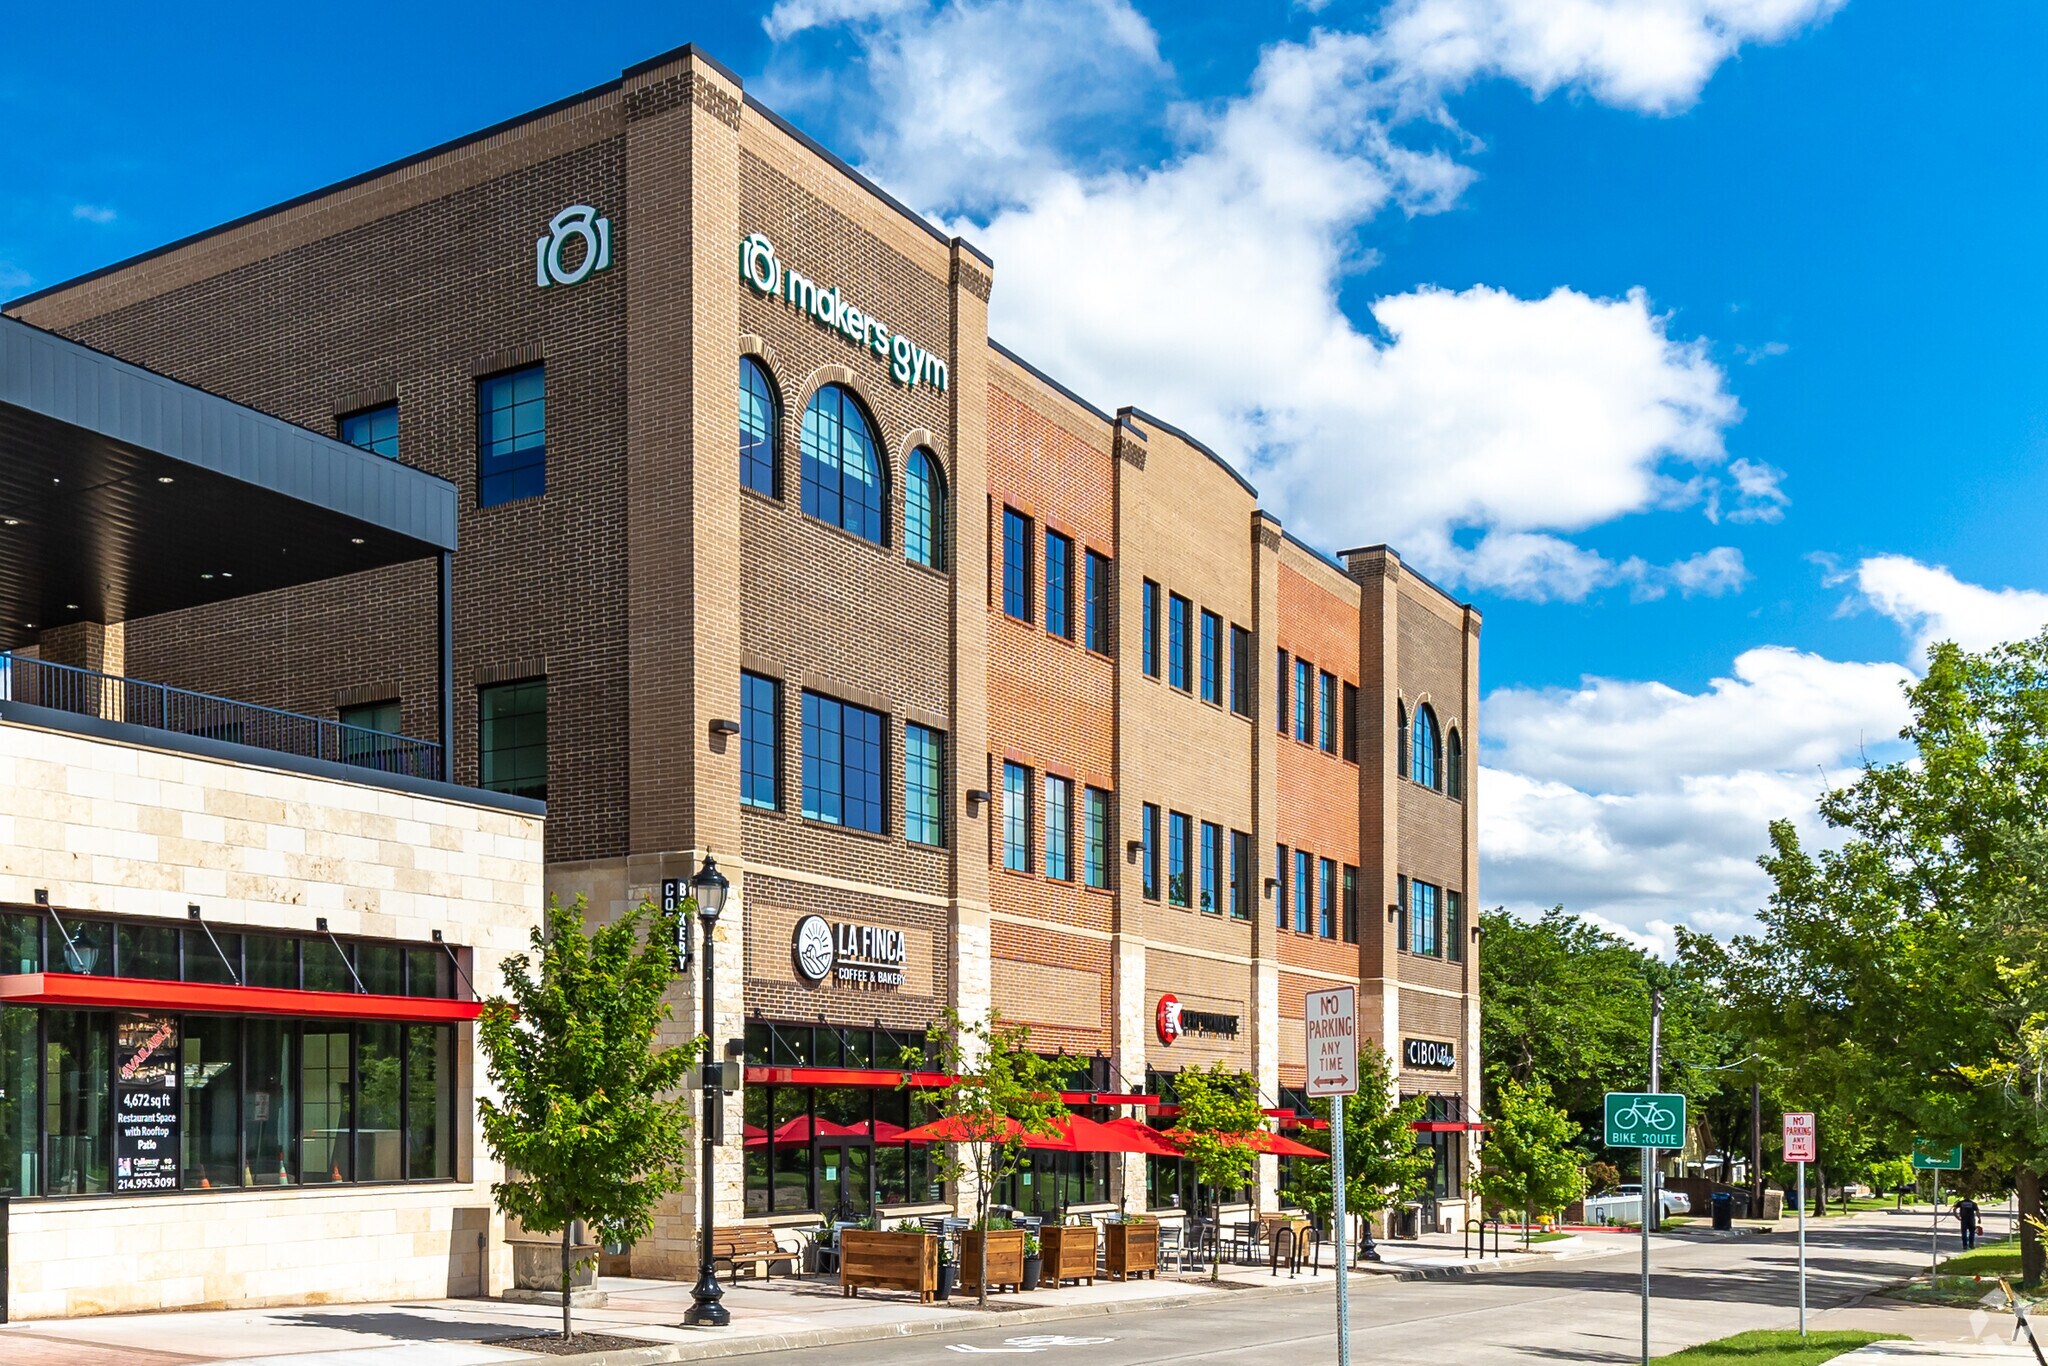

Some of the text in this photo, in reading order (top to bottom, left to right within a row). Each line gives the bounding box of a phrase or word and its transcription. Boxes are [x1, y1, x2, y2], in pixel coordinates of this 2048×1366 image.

[786, 269, 949, 391] makers gym
[838, 922, 906, 962] LA FINCA
[839, 967, 906, 985] COFFEE & BAKERY
[1320, 995, 1339, 1016] NO
[1309, 1016, 1352, 1039] PARKING
[122, 1023, 172, 1079] AVAILABLE
[1321, 1041, 1340, 1055] ANY
[1410, 1041, 1435, 1065] CIBO
[1320, 1057, 1343, 1071] TIME
[124, 1094, 170, 1108] 4,672 sq ft
[118, 1113, 176, 1124] Restaurant Space
[1793, 1117, 1804, 1125] NO
[125, 1126, 169, 1137] with Rooftop
[1612, 1133, 1677, 1144] BIKE ROUTE
[1786, 1127, 1811, 1136] PARKING
[138, 1140, 157, 1150] Patio
[118, 1178, 176, 1190] 214.995.9091
